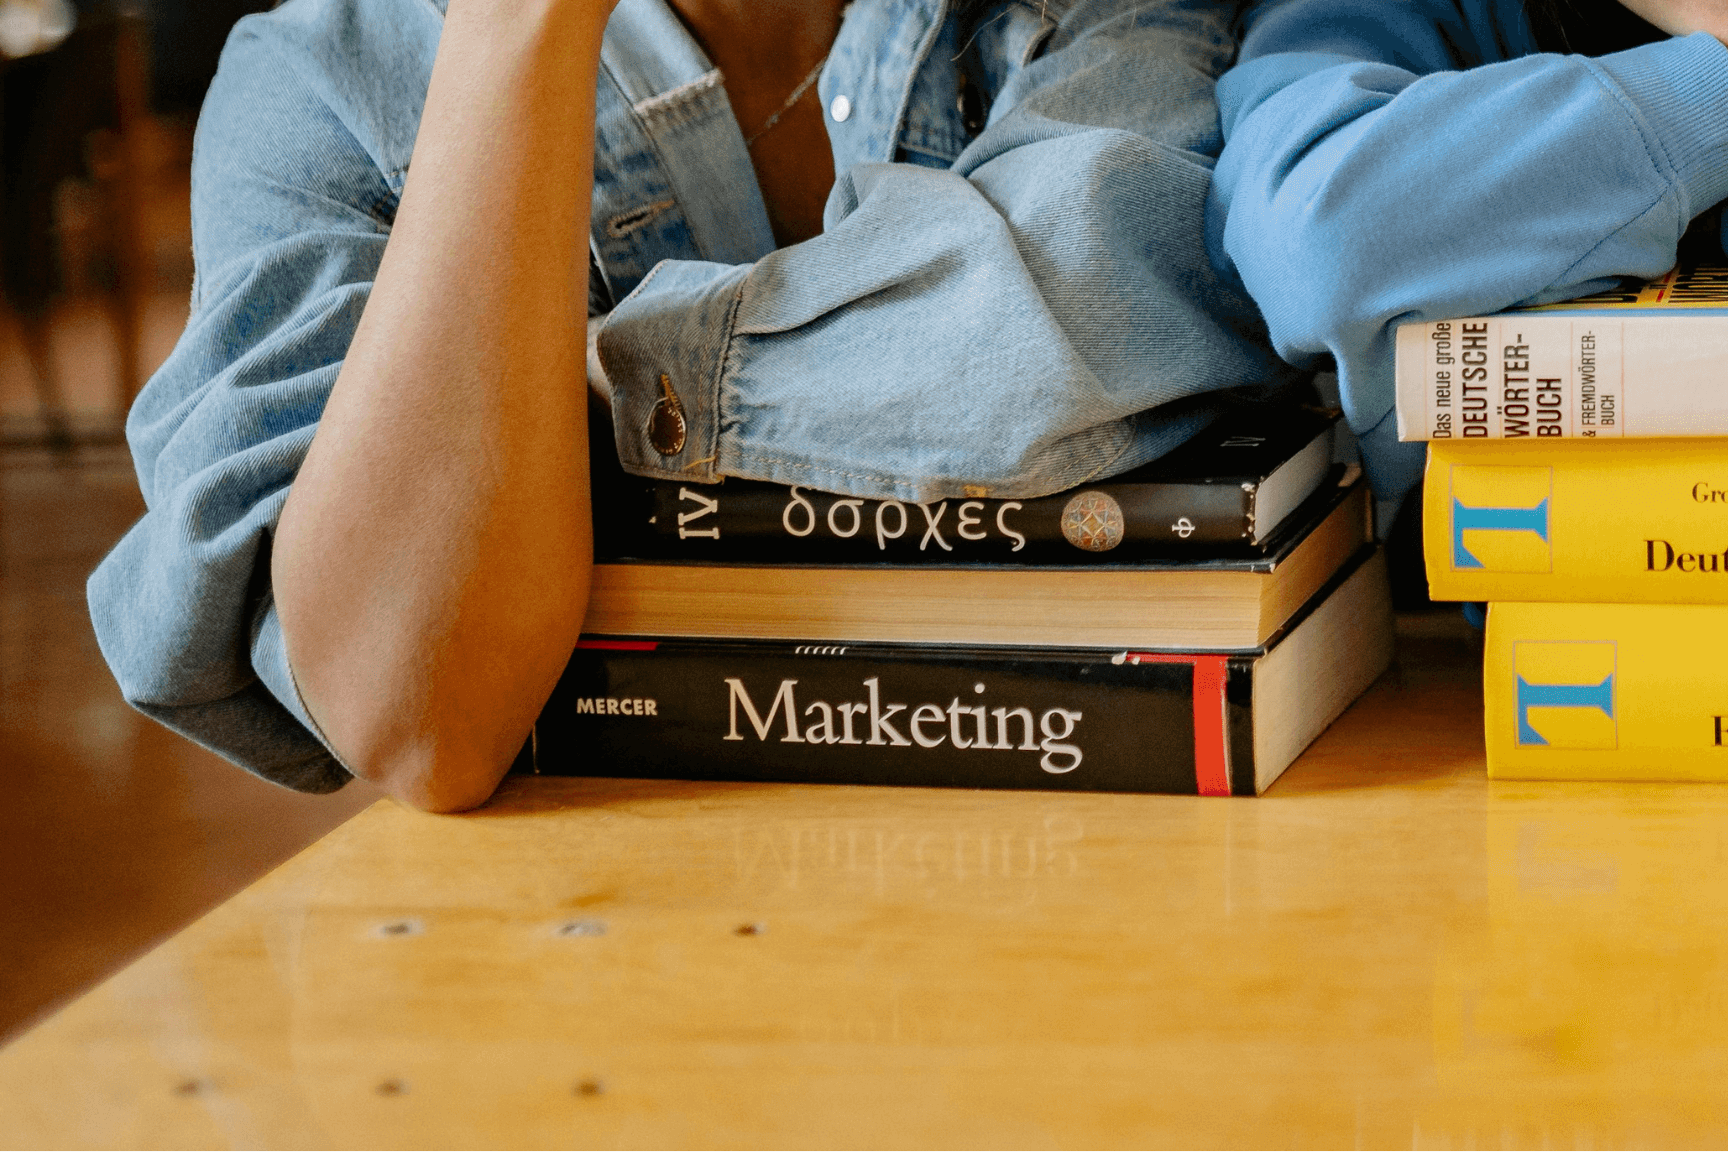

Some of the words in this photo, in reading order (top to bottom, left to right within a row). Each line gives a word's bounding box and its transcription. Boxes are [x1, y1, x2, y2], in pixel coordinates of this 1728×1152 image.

[1432, 322, 1455, 365] große
[1436, 370, 1452, 407] neue
[1462, 322, 1488, 438] DEUTSCHE
[1497, 333, 1530, 438] WÖRTER-
[1578, 330, 1596, 426] FREMDWÖRTER-
[1433, 413, 1452, 438] Das
[1536, 378, 1562, 438] BUCH
[1601, 394, 1615, 426] BUCH
[1581, 430, 1596, 438] &
[678, 488, 720, 539] IV
[576, 698, 658, 716] MERCER
[723, 677, 1083, 774] Marketing
